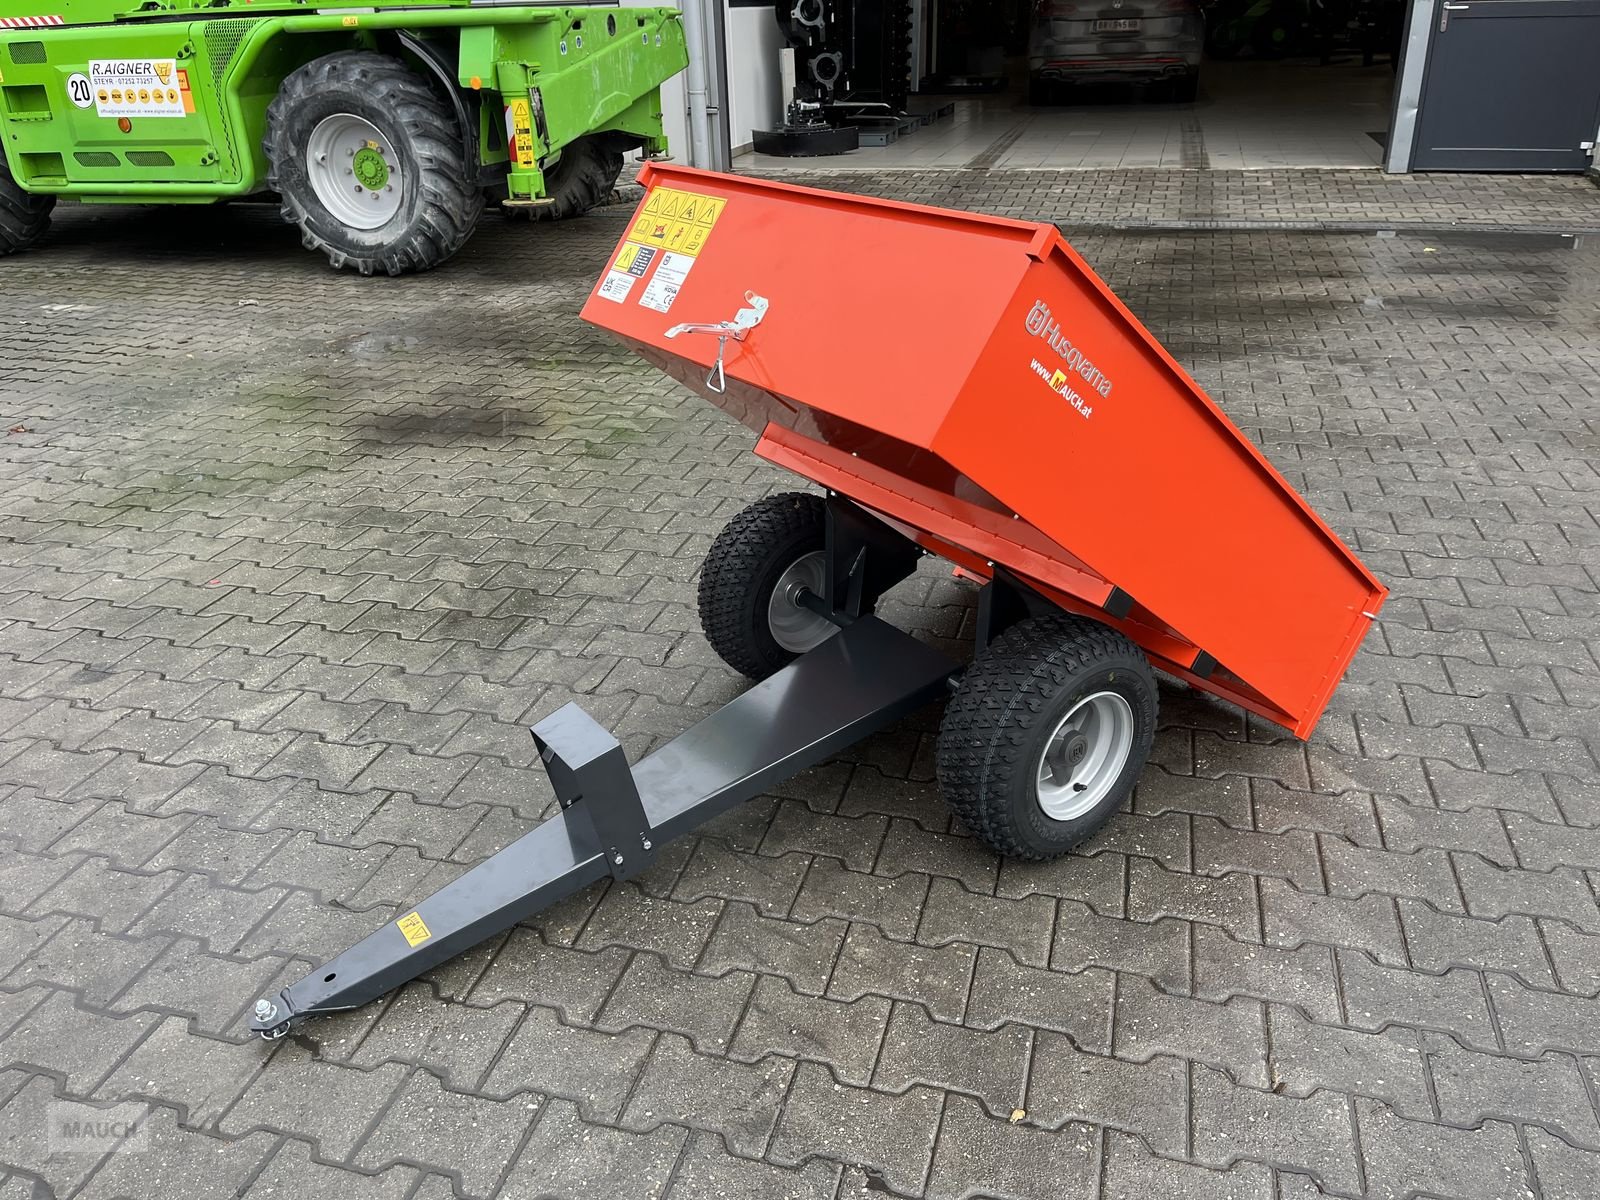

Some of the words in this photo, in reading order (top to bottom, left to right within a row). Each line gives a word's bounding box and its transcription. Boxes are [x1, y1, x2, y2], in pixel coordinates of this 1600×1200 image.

[92, 63, 152, 75] R.AIGNER
[71, 79, 91, 102] 20
[1041, 317, 1113, 398] Husqvarna
[1030, 358, 1093, 419] www.MAUCH.at
